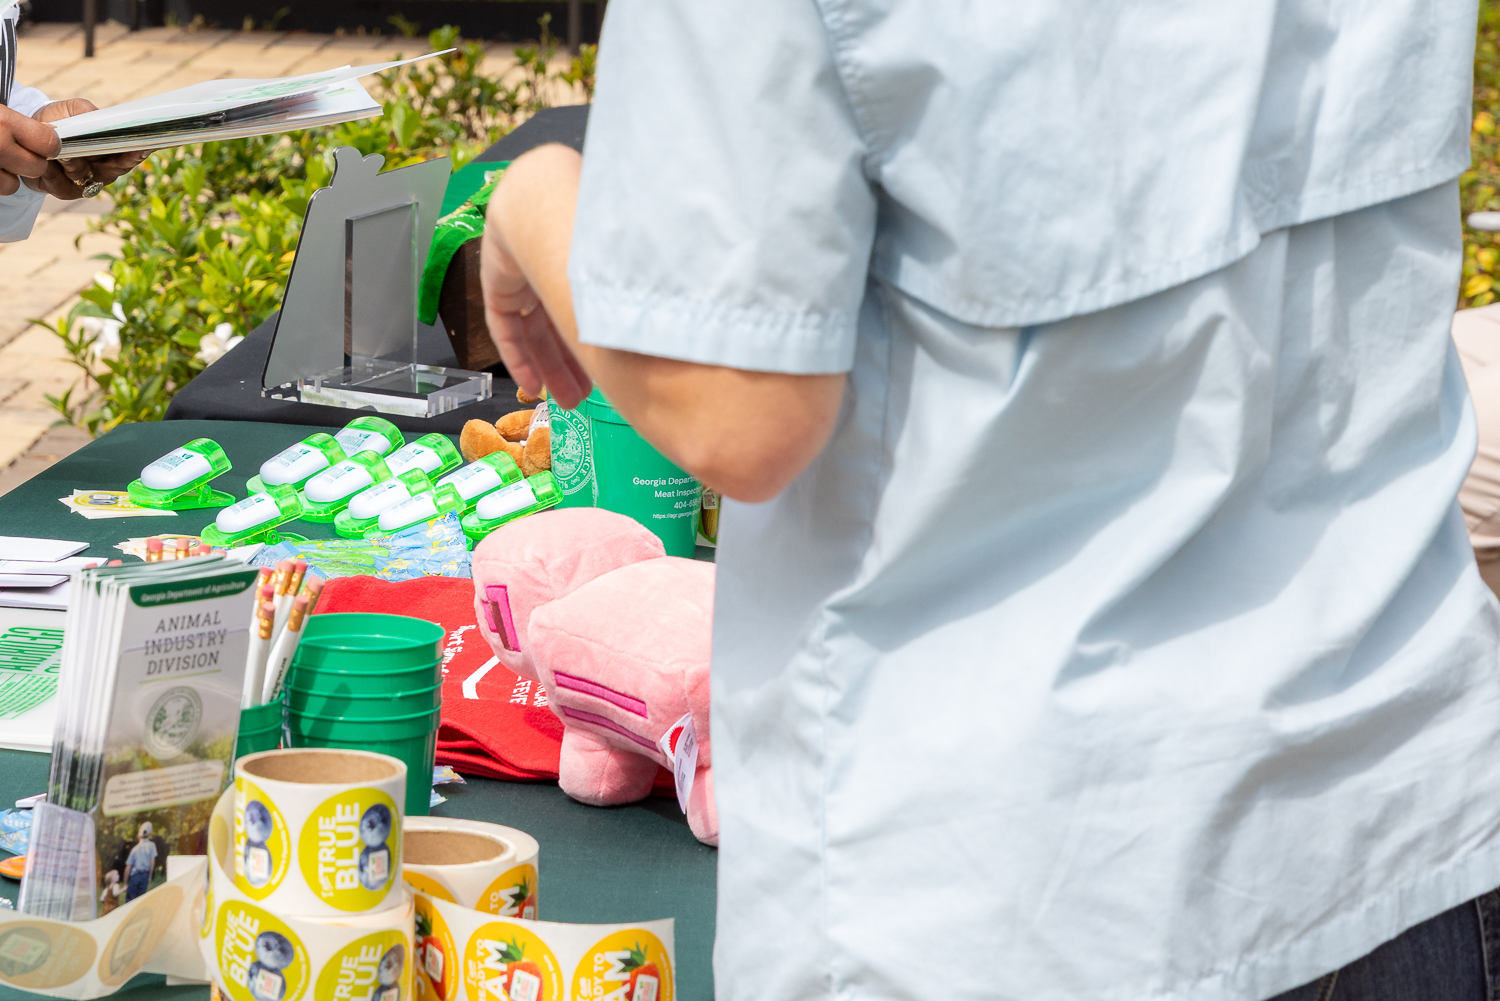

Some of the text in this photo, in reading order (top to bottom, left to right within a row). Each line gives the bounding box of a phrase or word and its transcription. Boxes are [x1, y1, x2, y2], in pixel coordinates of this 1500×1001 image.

[632, 476, 666, 487] Georgia
[155, 610, 222, 634] ANIMAL
[144, 628, 227, 656] INDUSTRY
[146, 650, 220, 676] DIVISION
[510, 680, 532, 705] FEVE
[318, 816, 336, 875] TRUE
[335, 802, 360, 890] BLUE
[222, 910, 238, 962] TRUE
[229, 910, 260, 988] BLUE
[476, 938, 486, 957] TO
[484, 938, 508, 1001] AM
[594, 953, 604, 973] TO
[604, 950, 632, 1001] AM
